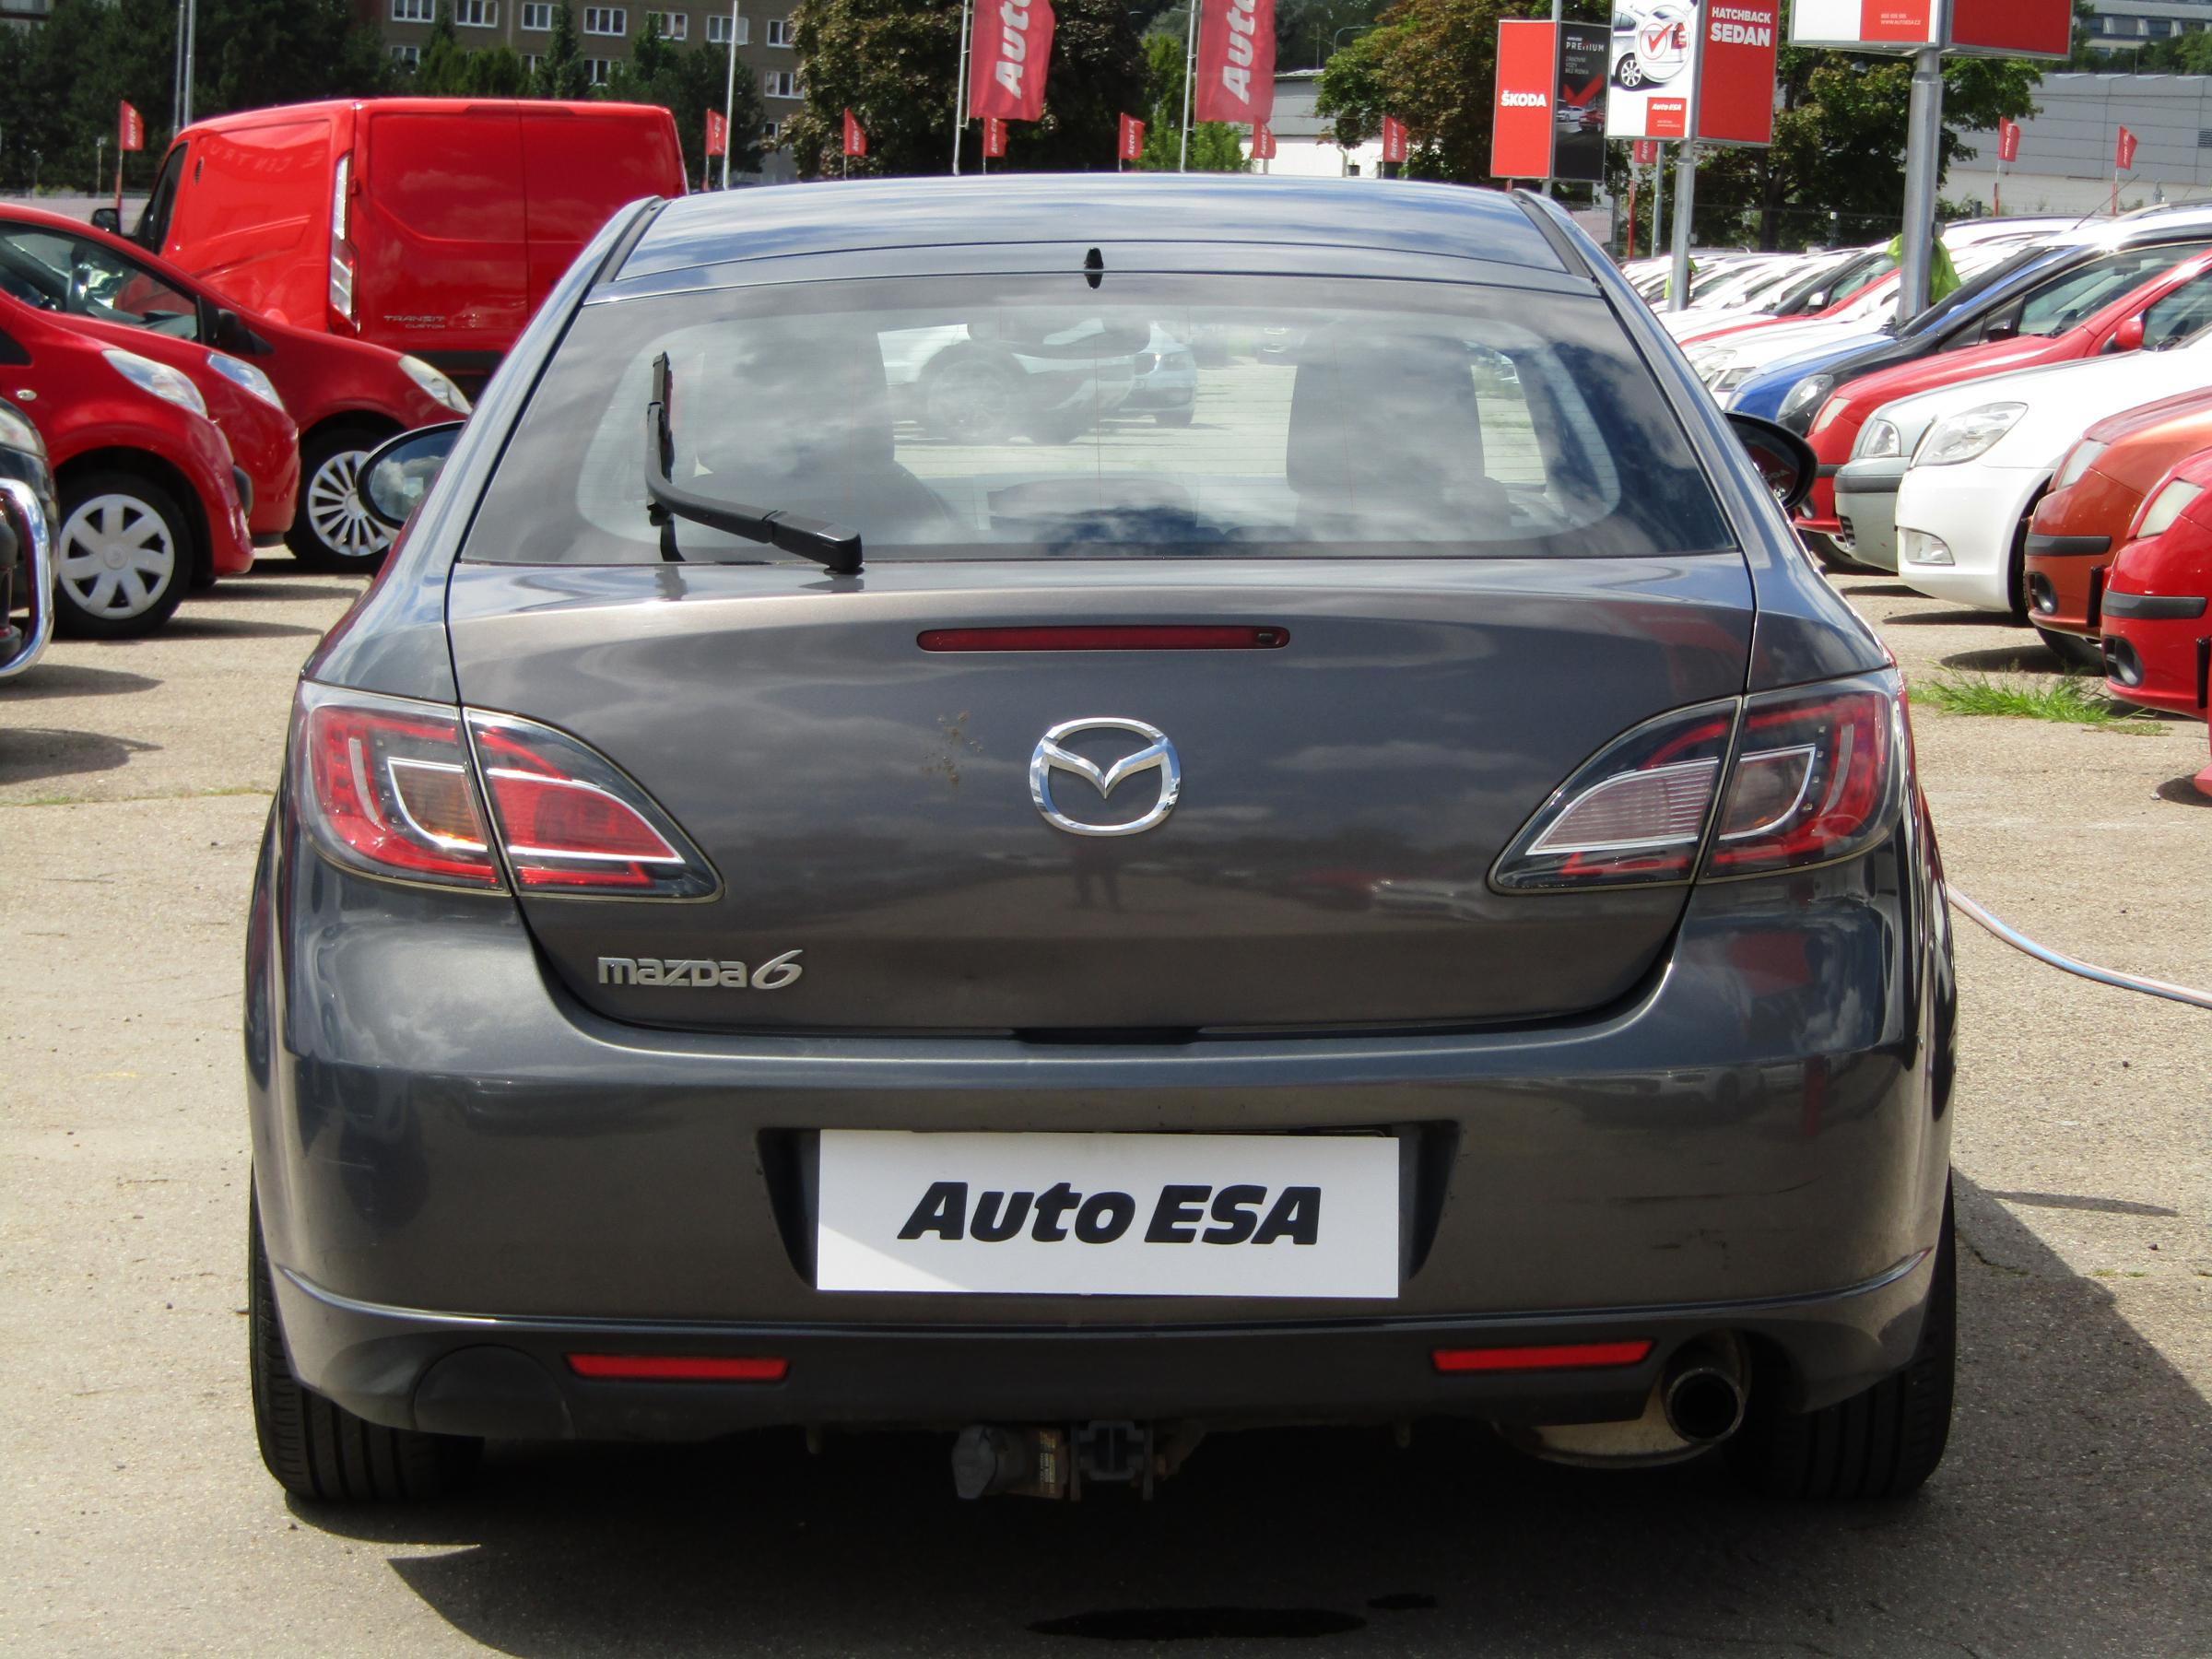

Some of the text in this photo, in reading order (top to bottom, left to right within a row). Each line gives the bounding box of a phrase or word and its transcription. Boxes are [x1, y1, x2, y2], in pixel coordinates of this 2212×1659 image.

[1712, 6, 1771, 24] HATCHBACK
[1710, 22, 1771, 47] SEDAN
[995, 0, 1030, 100] Aut
[1500, 89, 1547, 107] ŠKODA
[1652, 102, 1668, 111] Auto
[383, 314, 445, 323] TRANSIT
[897, 1182, 1322, 1246] Auto ESA
